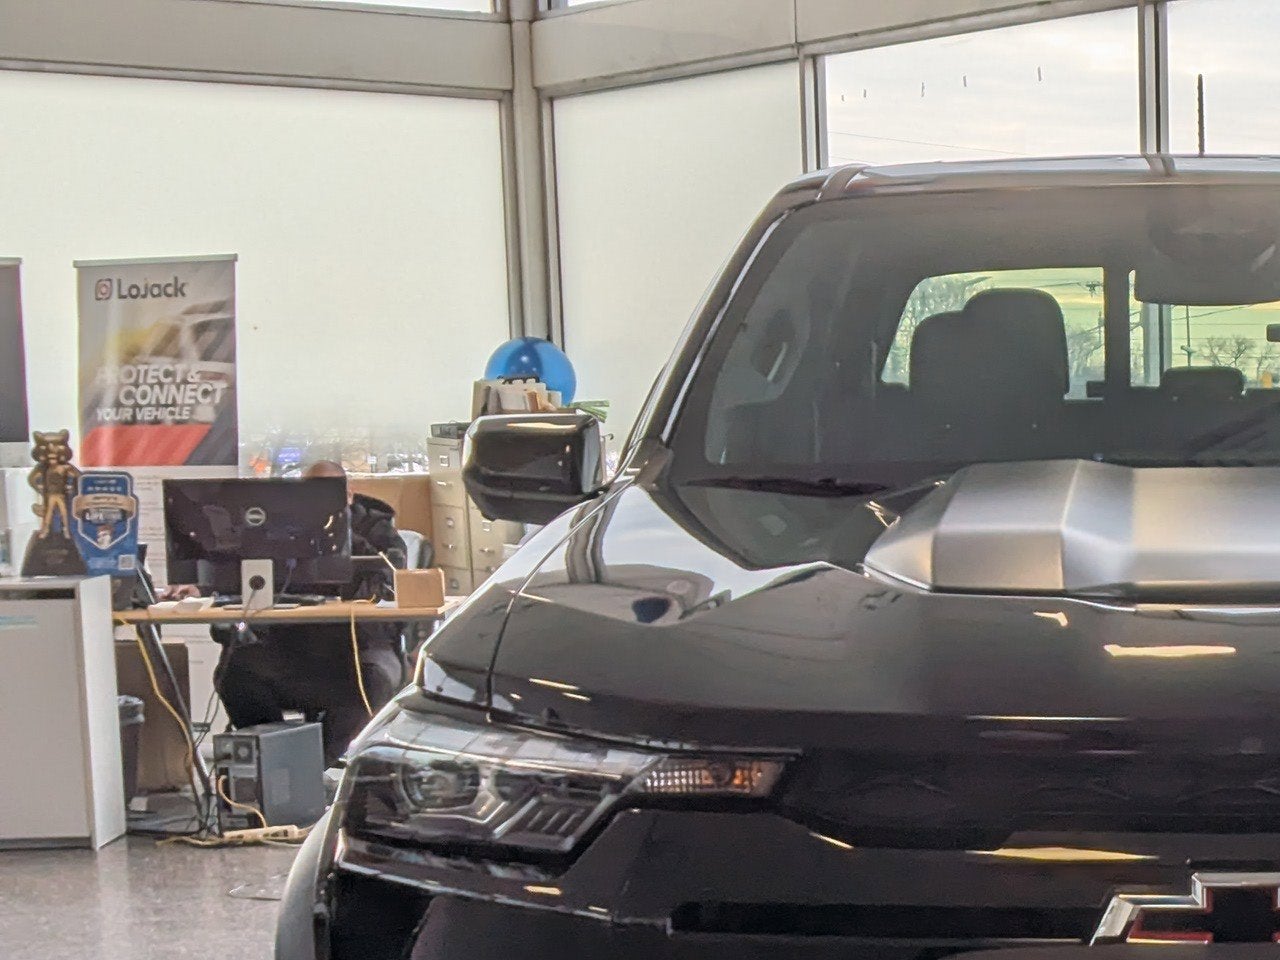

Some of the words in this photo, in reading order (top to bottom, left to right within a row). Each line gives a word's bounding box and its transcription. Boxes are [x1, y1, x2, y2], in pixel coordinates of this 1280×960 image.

[118, 382, 228, 406] CONNECT
[96, 407, 134, 422] YOUR
[136, 406, 191, 421] VEHICLE
